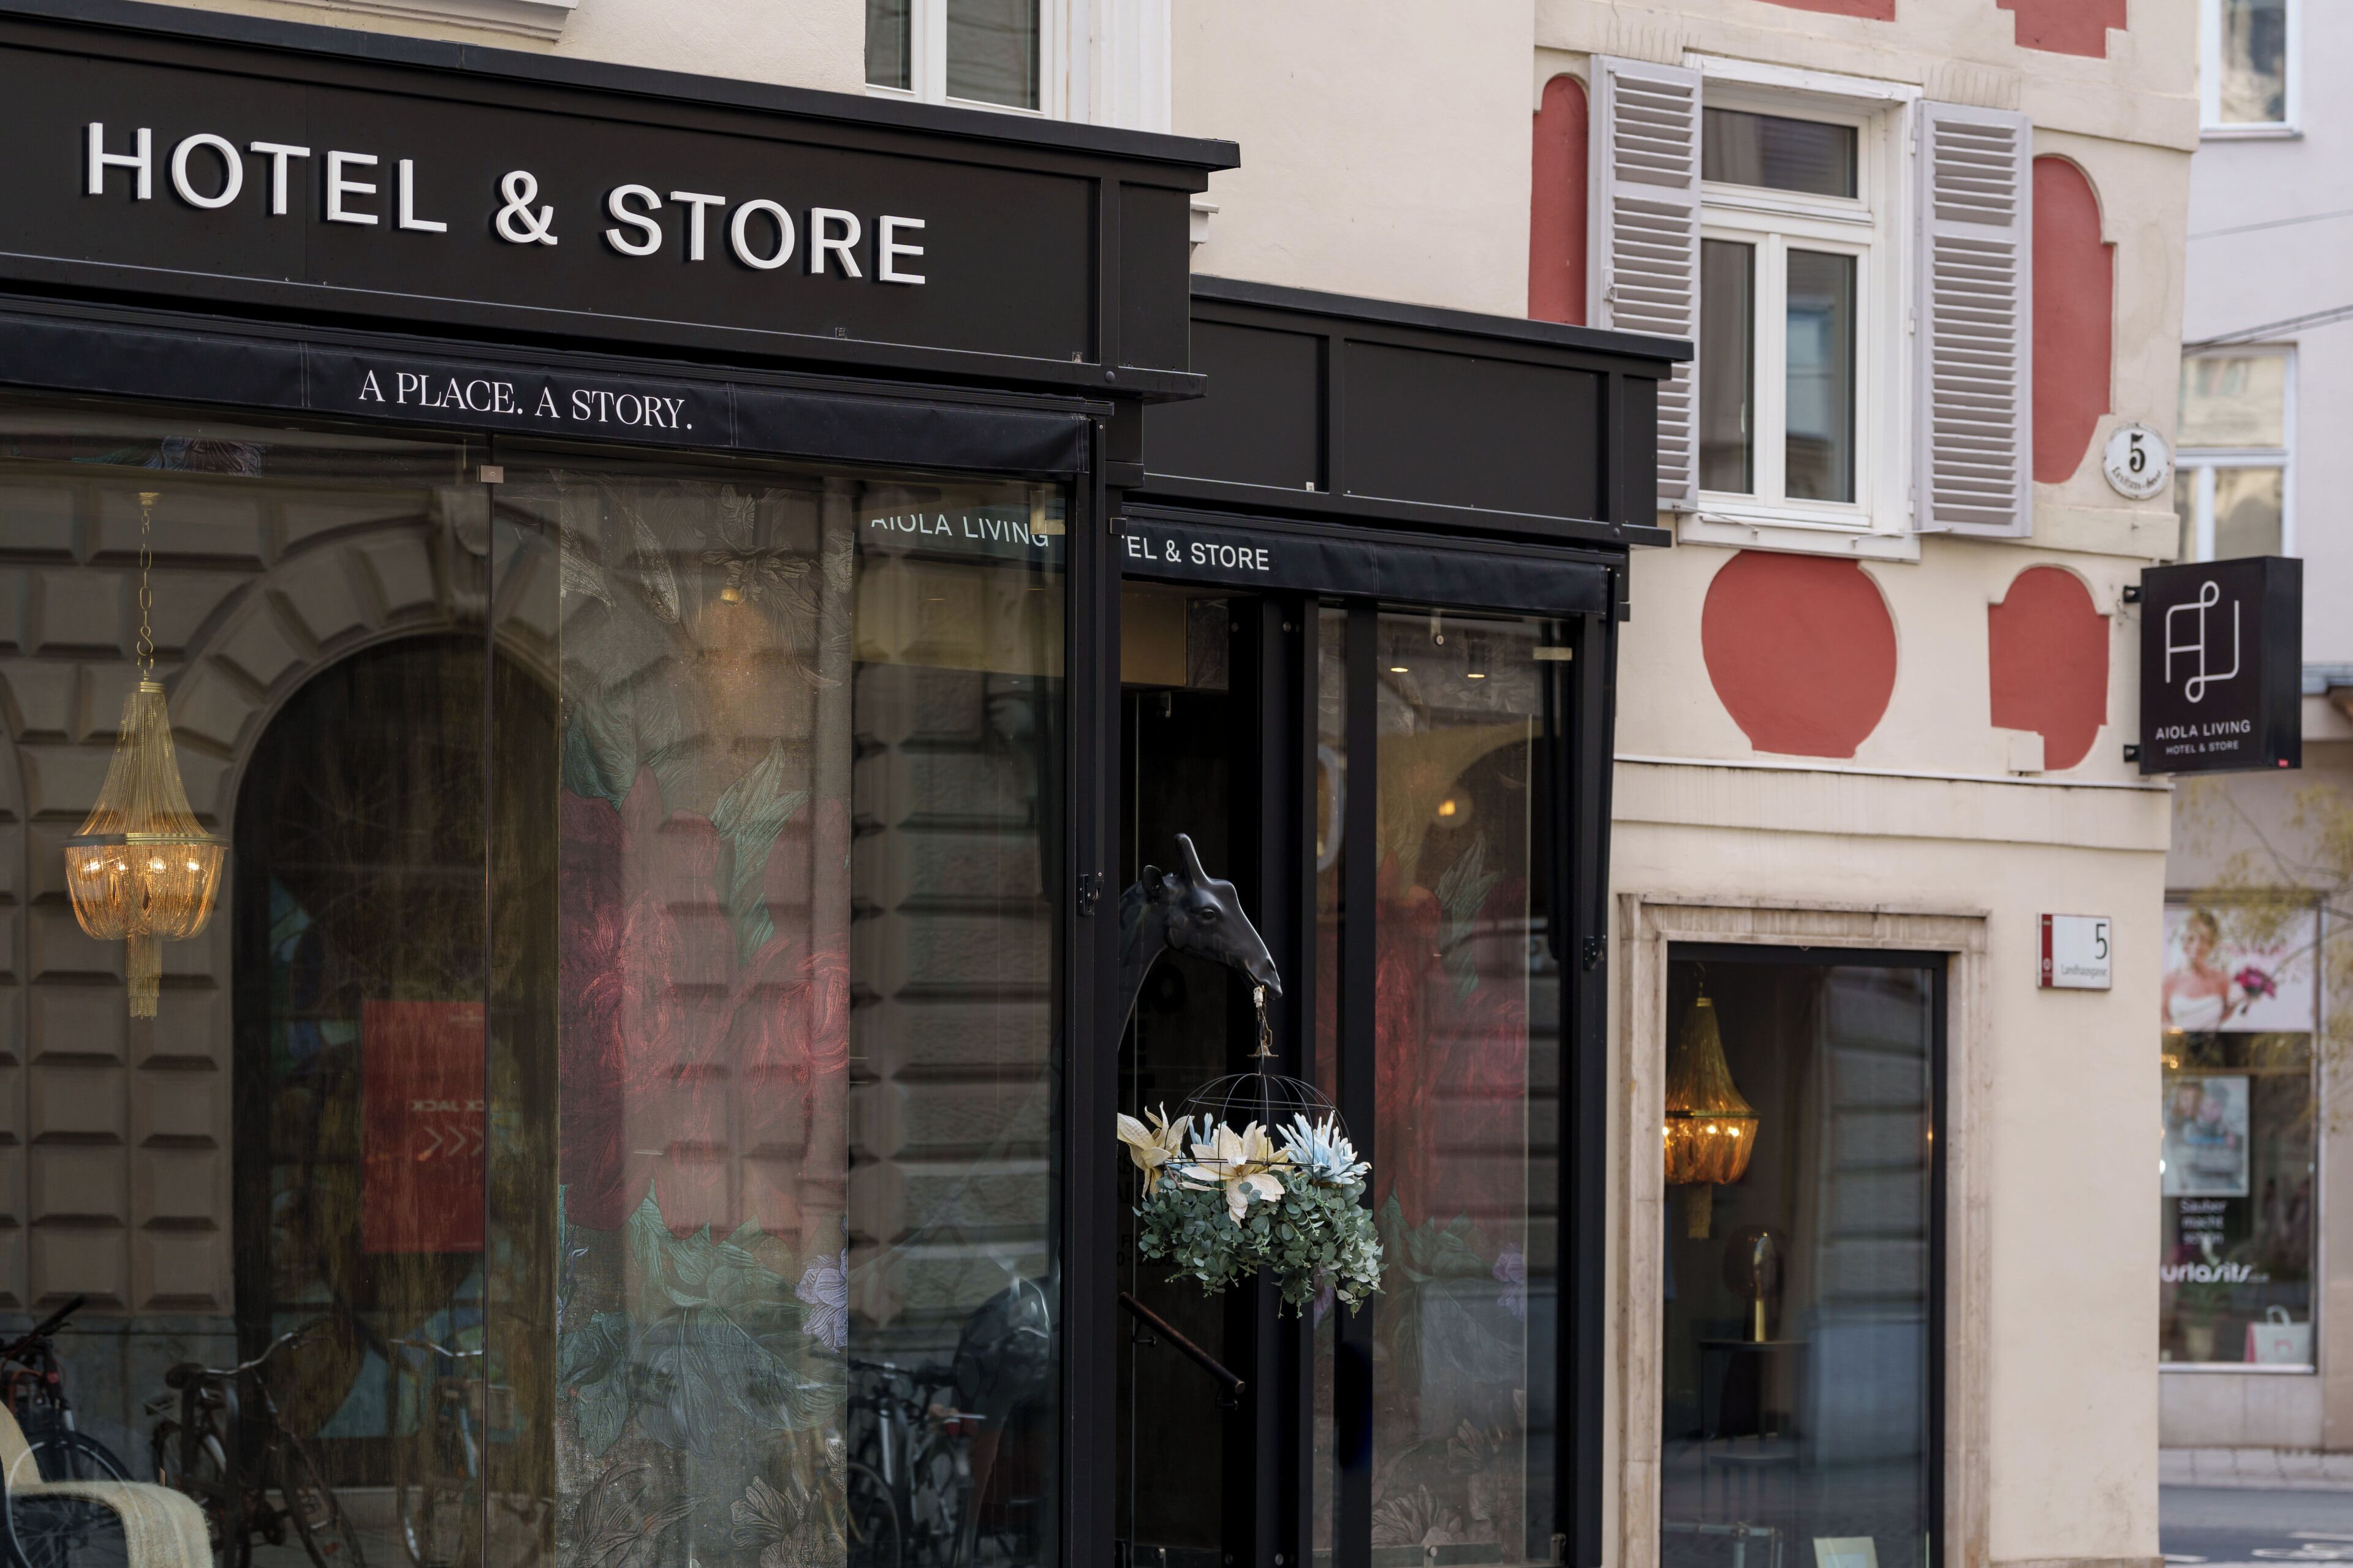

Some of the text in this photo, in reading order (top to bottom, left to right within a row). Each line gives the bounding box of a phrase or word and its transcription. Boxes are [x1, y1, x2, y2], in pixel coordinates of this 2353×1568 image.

[85, 123, 926, 285] HOTEL & STORE
[358, 369, 693, 431] A PLACE. A STORY.
[2129, 433, 2146, 472] 5
[1121, 534, 1270, 571] EL & STORE
[2155, 719, 2251, 740] AIOLA LIVING
[2165, 740, 2240, 756] HOTEL & STORE
[2095, 923, 2108, 960] 5
